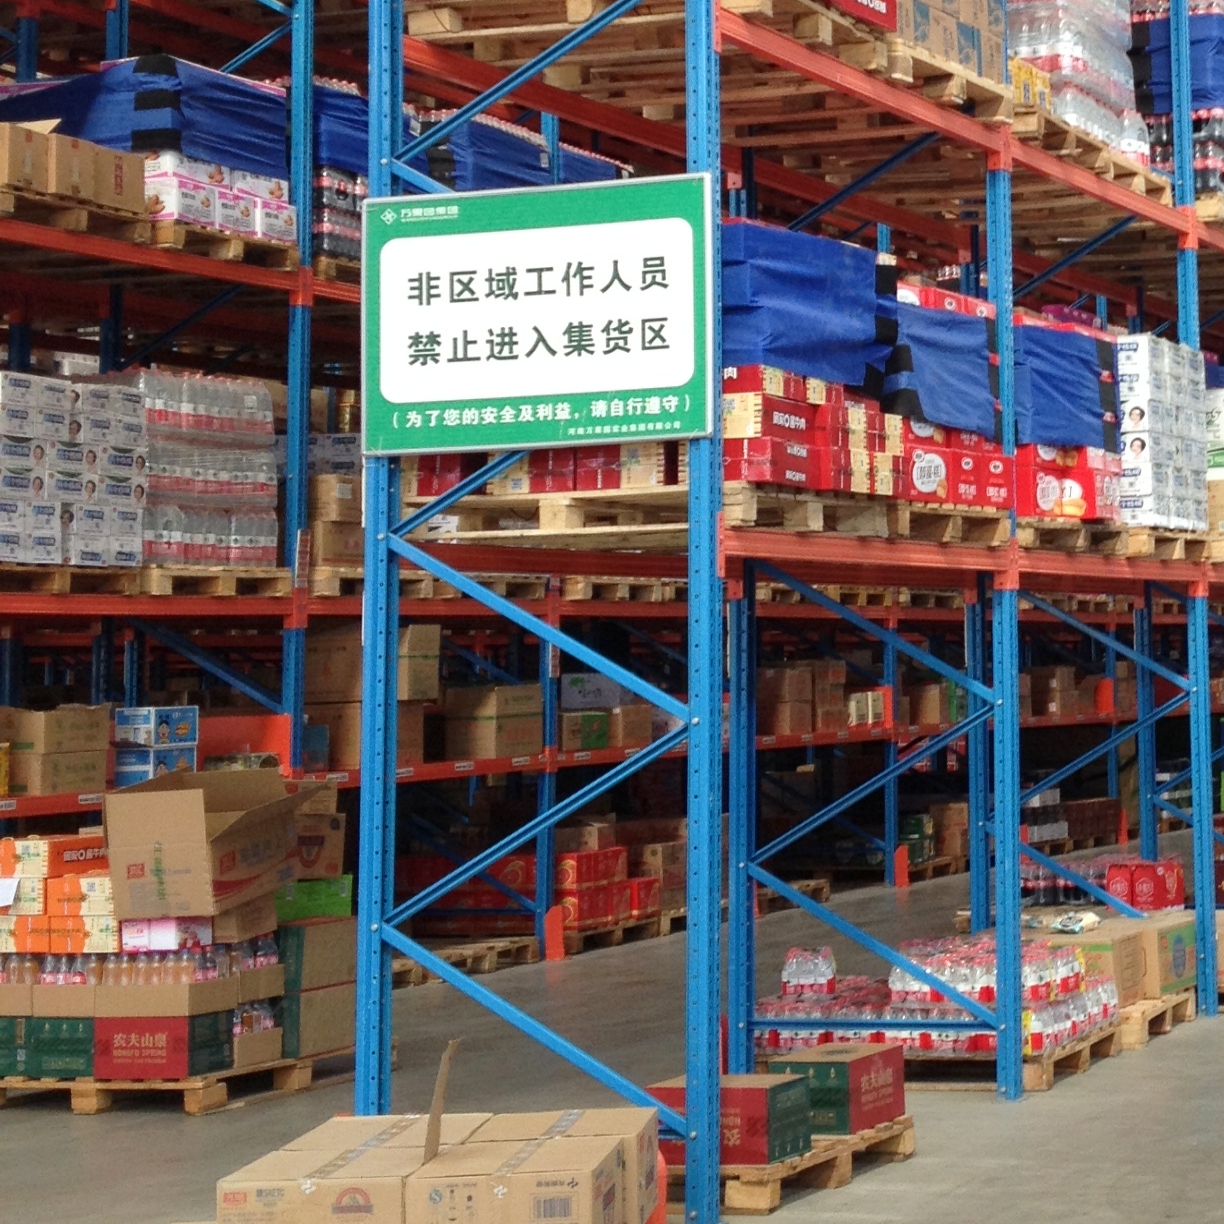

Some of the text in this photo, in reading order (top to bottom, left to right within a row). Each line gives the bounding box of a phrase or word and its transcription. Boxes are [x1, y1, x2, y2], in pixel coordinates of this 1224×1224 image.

[407, 256, 670, 306] 非区域工作人员
[407, 317, 670, 367] 禁止进入集货区
